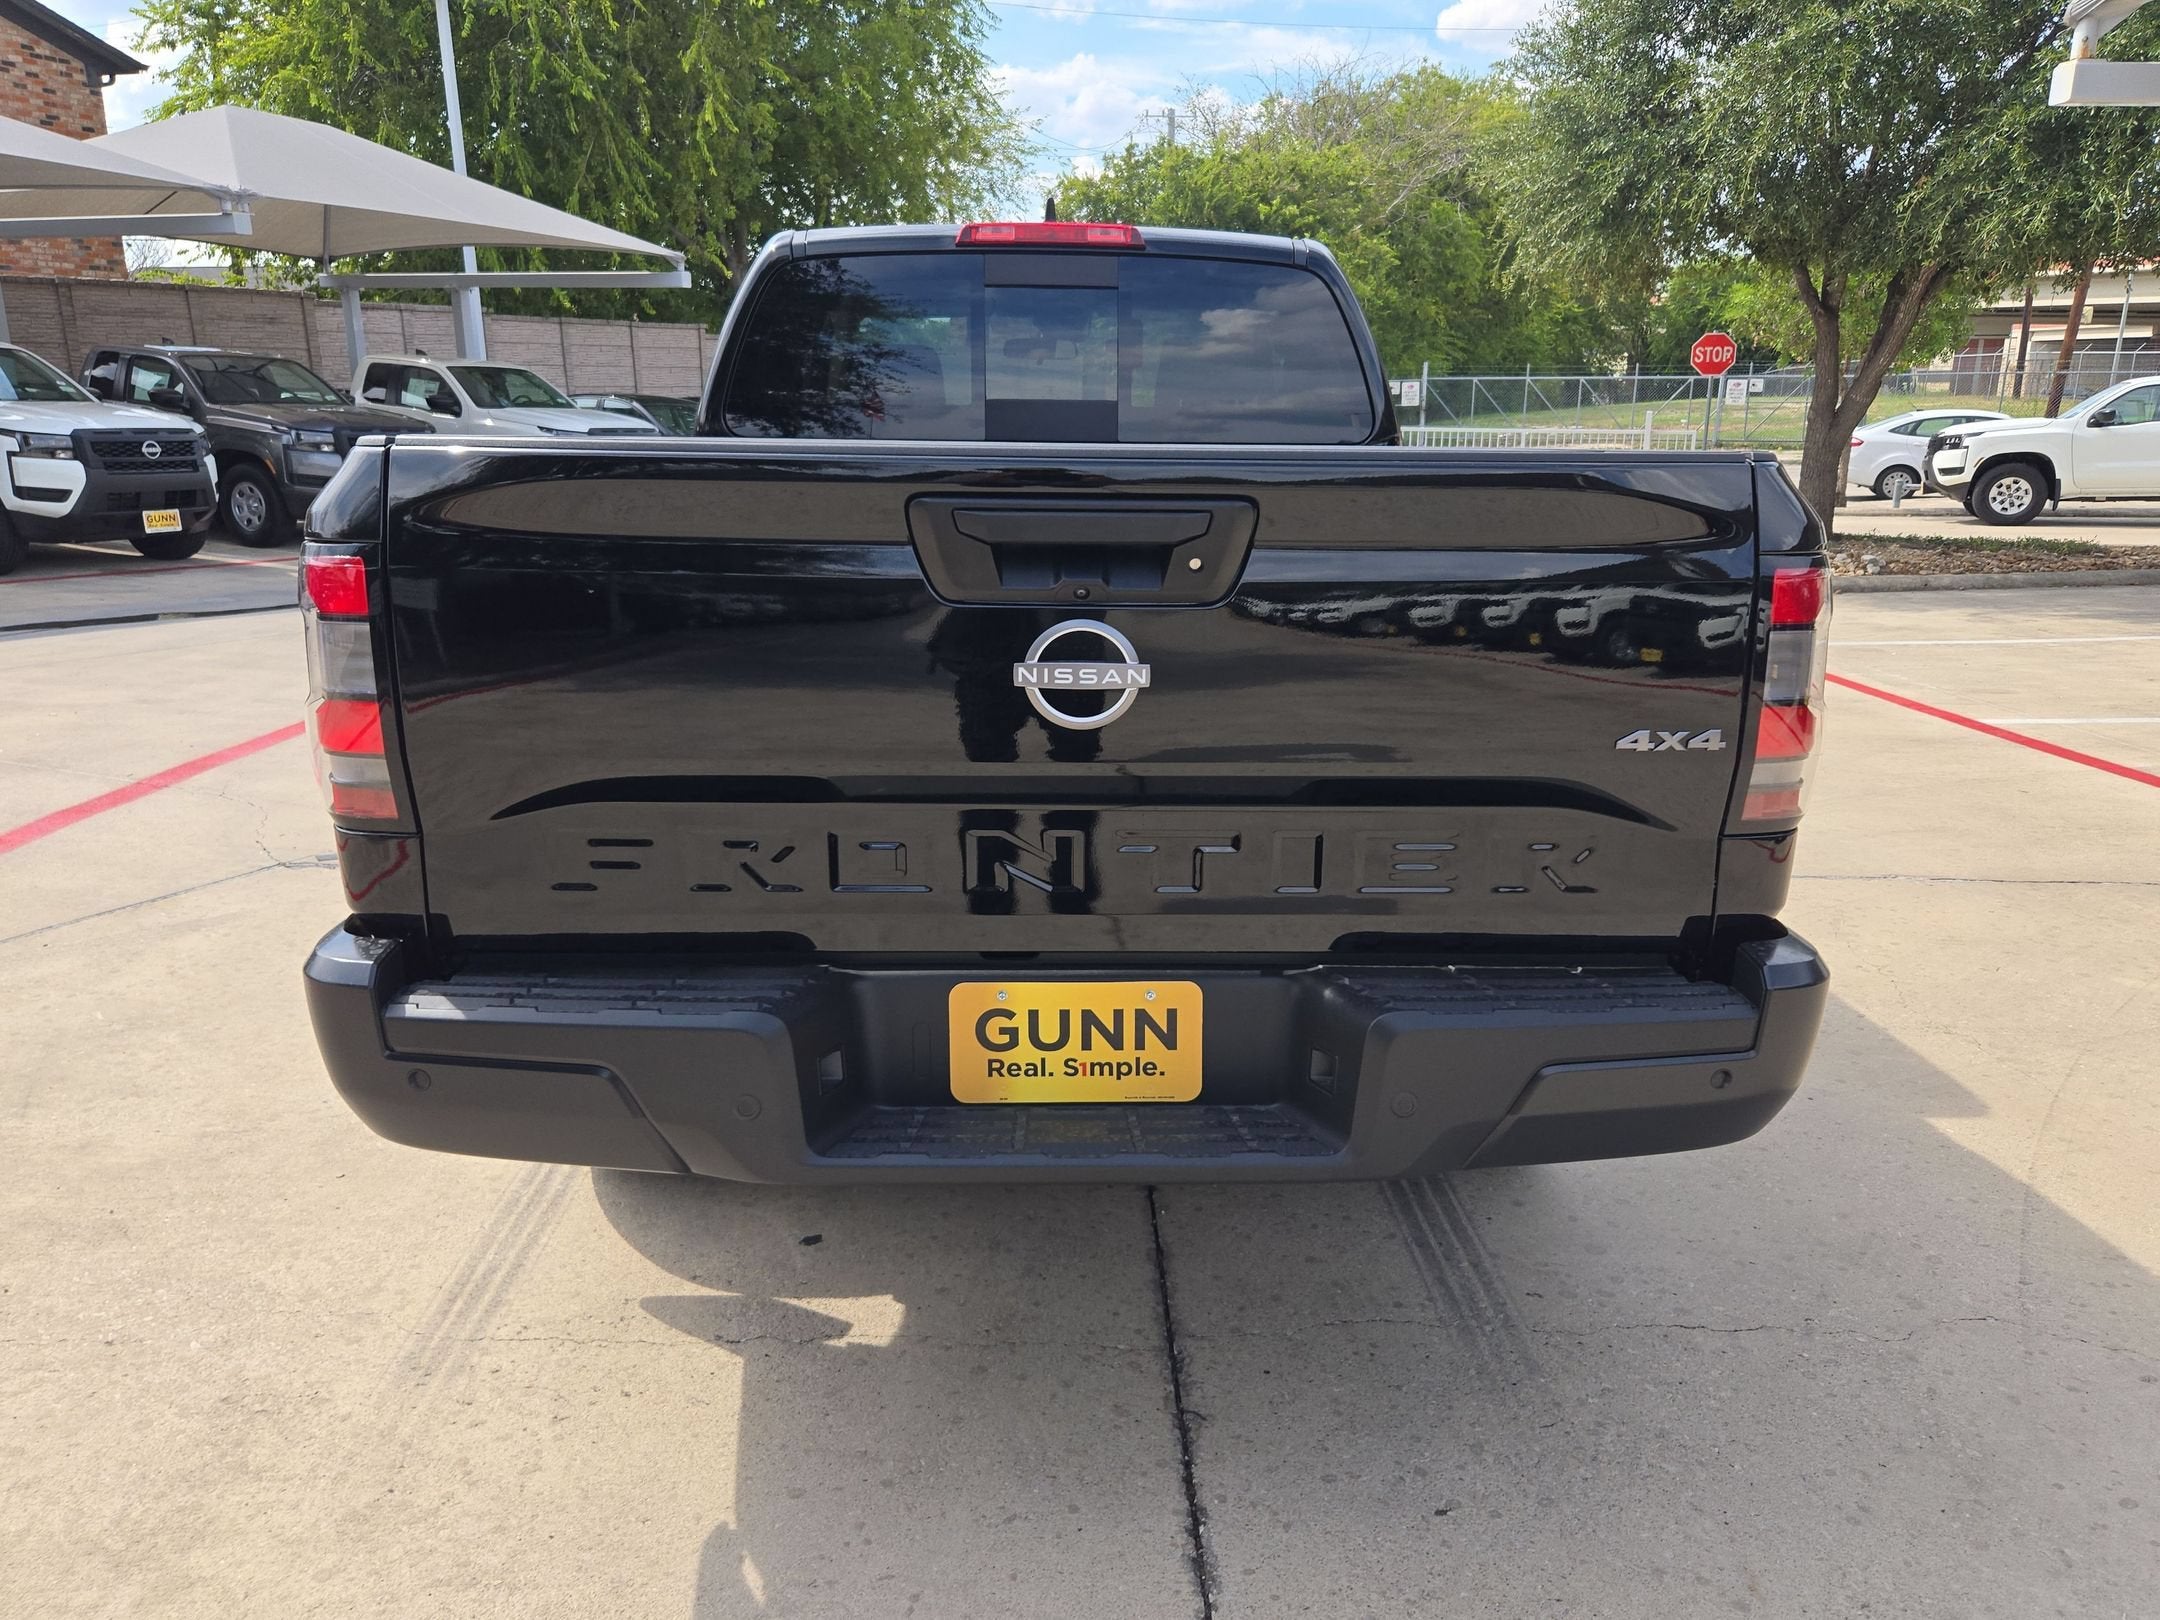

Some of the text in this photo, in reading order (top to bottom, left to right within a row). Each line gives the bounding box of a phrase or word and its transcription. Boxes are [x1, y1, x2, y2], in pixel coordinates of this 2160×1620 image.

[1694, 346, 1733, 363] STOP
[146, 513, 176, 524] GUNN
[1017, 666, 1146, 685] NISSAN
[550, 828, 1600, 894] FRONTIER
[974, 1007, 1178, 1052] GUNN
[987, 1057, 1054, 1078] Real.
